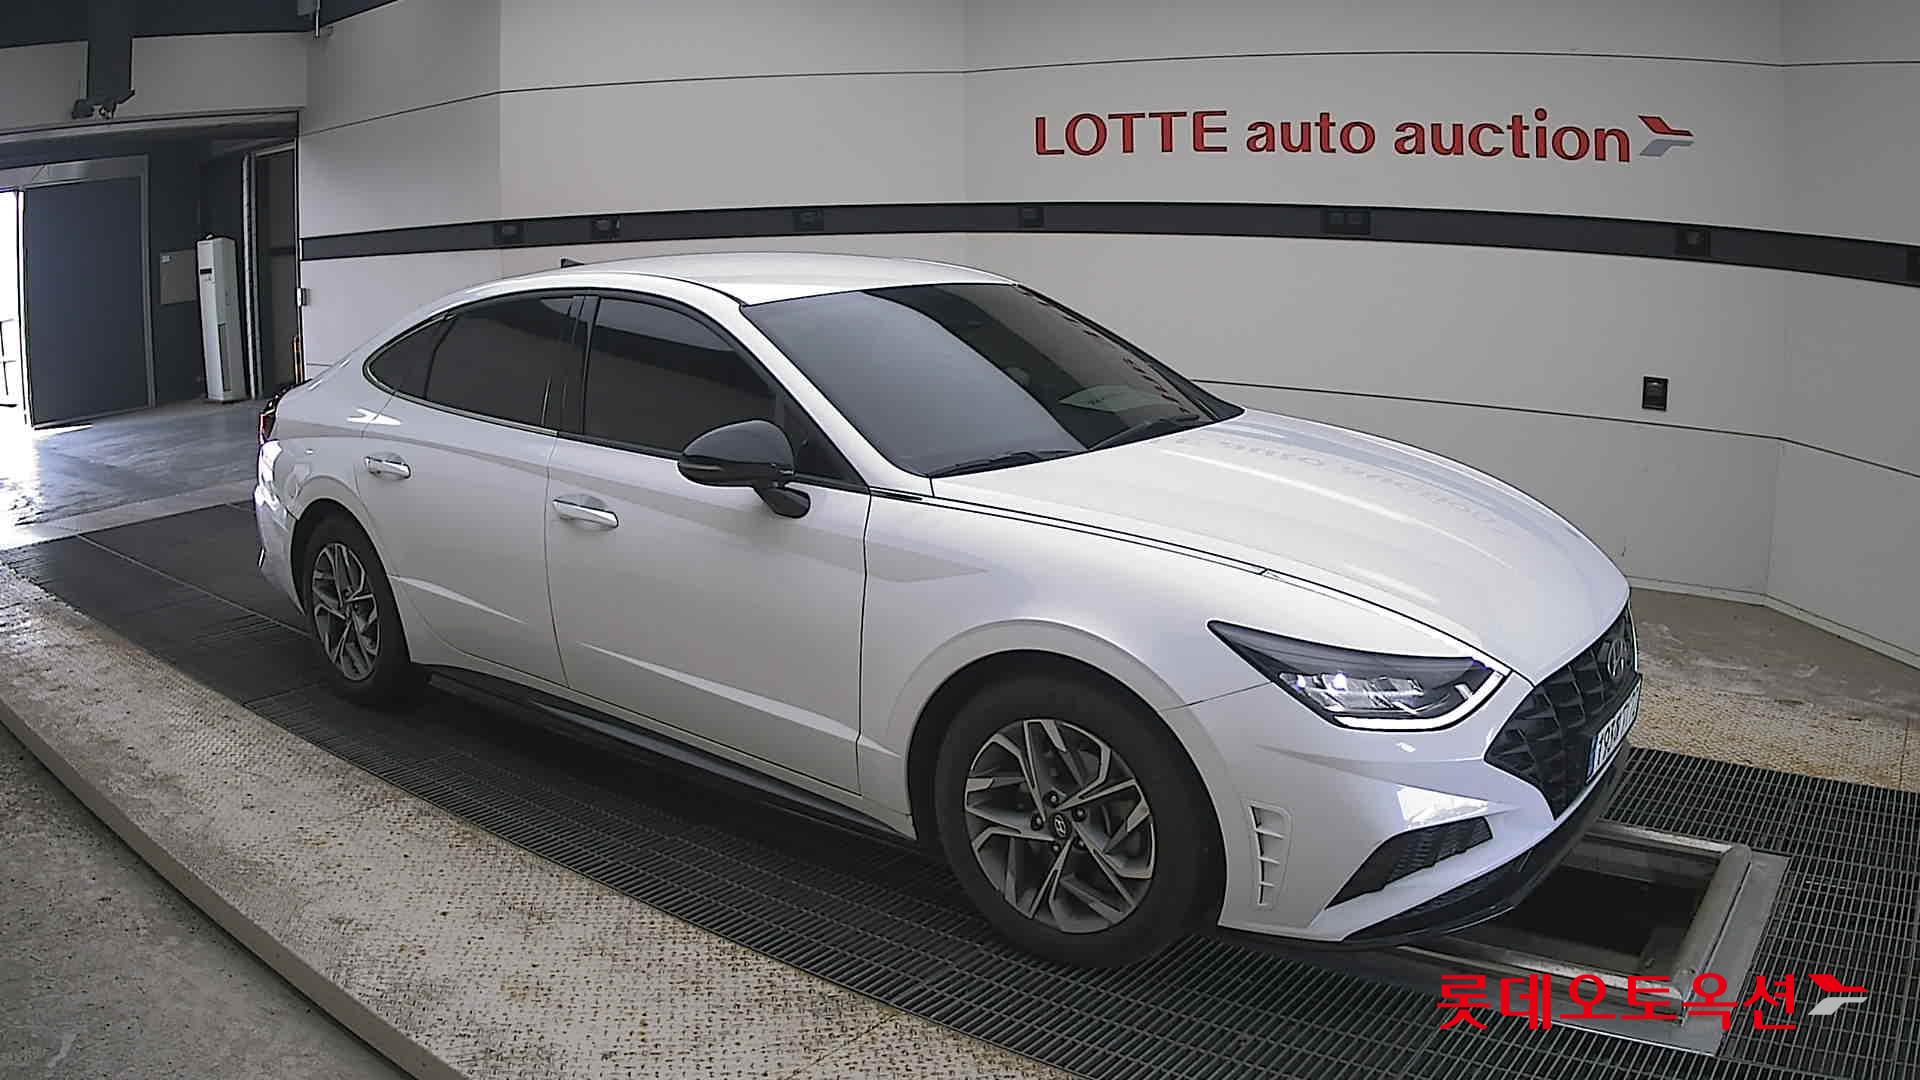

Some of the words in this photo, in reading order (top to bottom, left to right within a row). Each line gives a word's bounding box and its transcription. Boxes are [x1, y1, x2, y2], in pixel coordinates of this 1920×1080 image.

[1034, 110, 1228, 155] LOTTE
[1246, 111, 1376, 154] auto
[1394, 108, 1632, 162] auction
